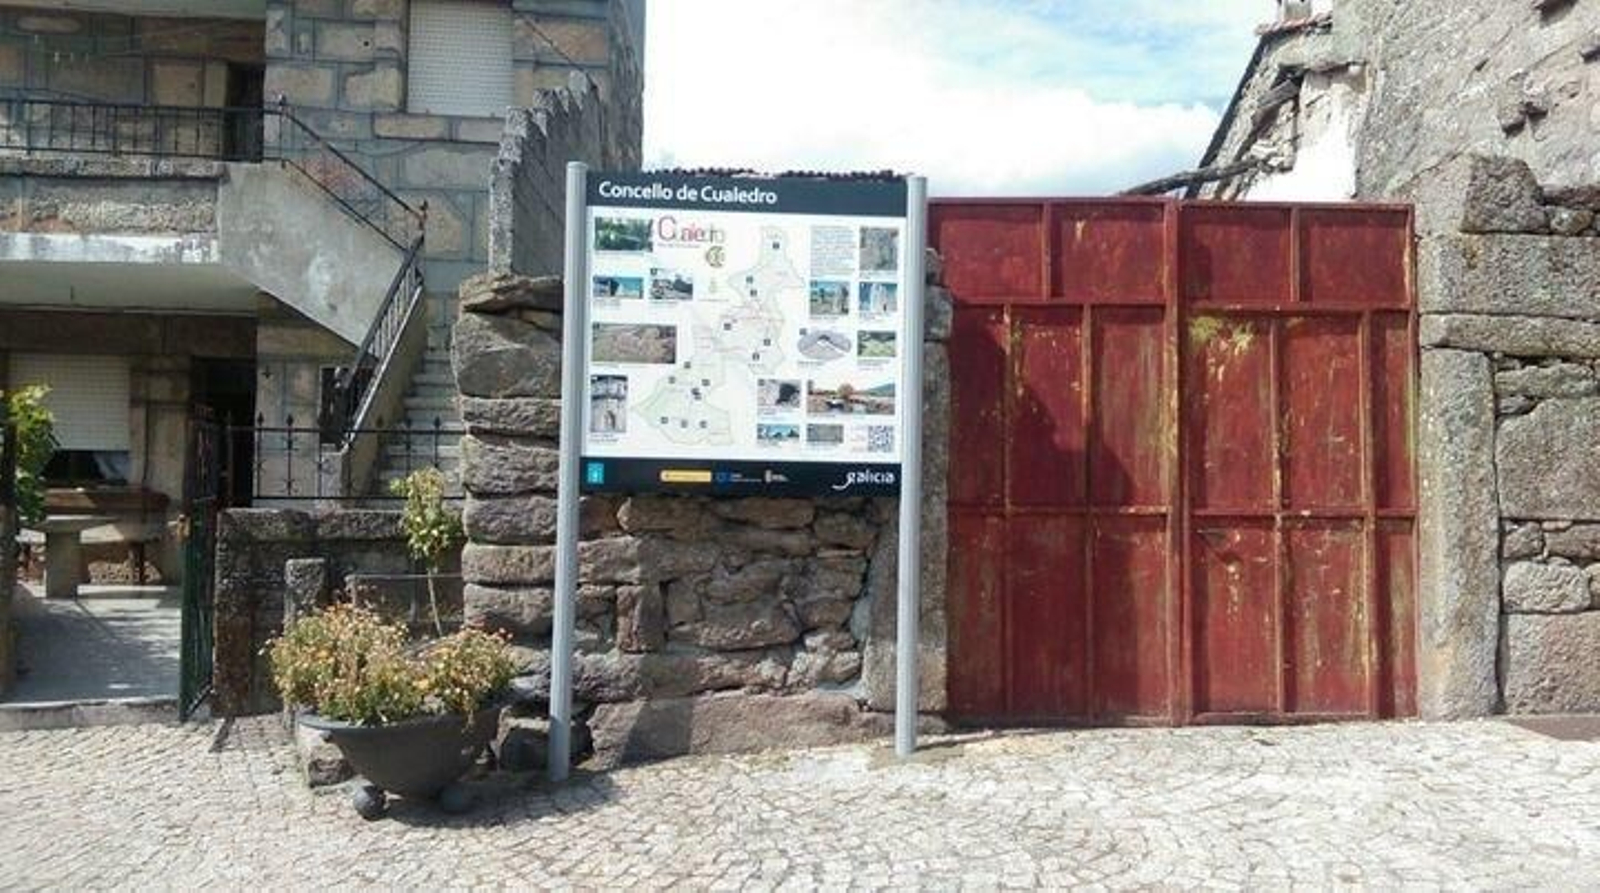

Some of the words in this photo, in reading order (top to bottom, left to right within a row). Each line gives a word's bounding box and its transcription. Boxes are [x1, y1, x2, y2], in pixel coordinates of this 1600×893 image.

[598, 181, 672, 201] Concello
[676, 183, 697, 201] de
[701, 185, 778, 204] Cualedro
[831, 470, 895, 490] galicia
